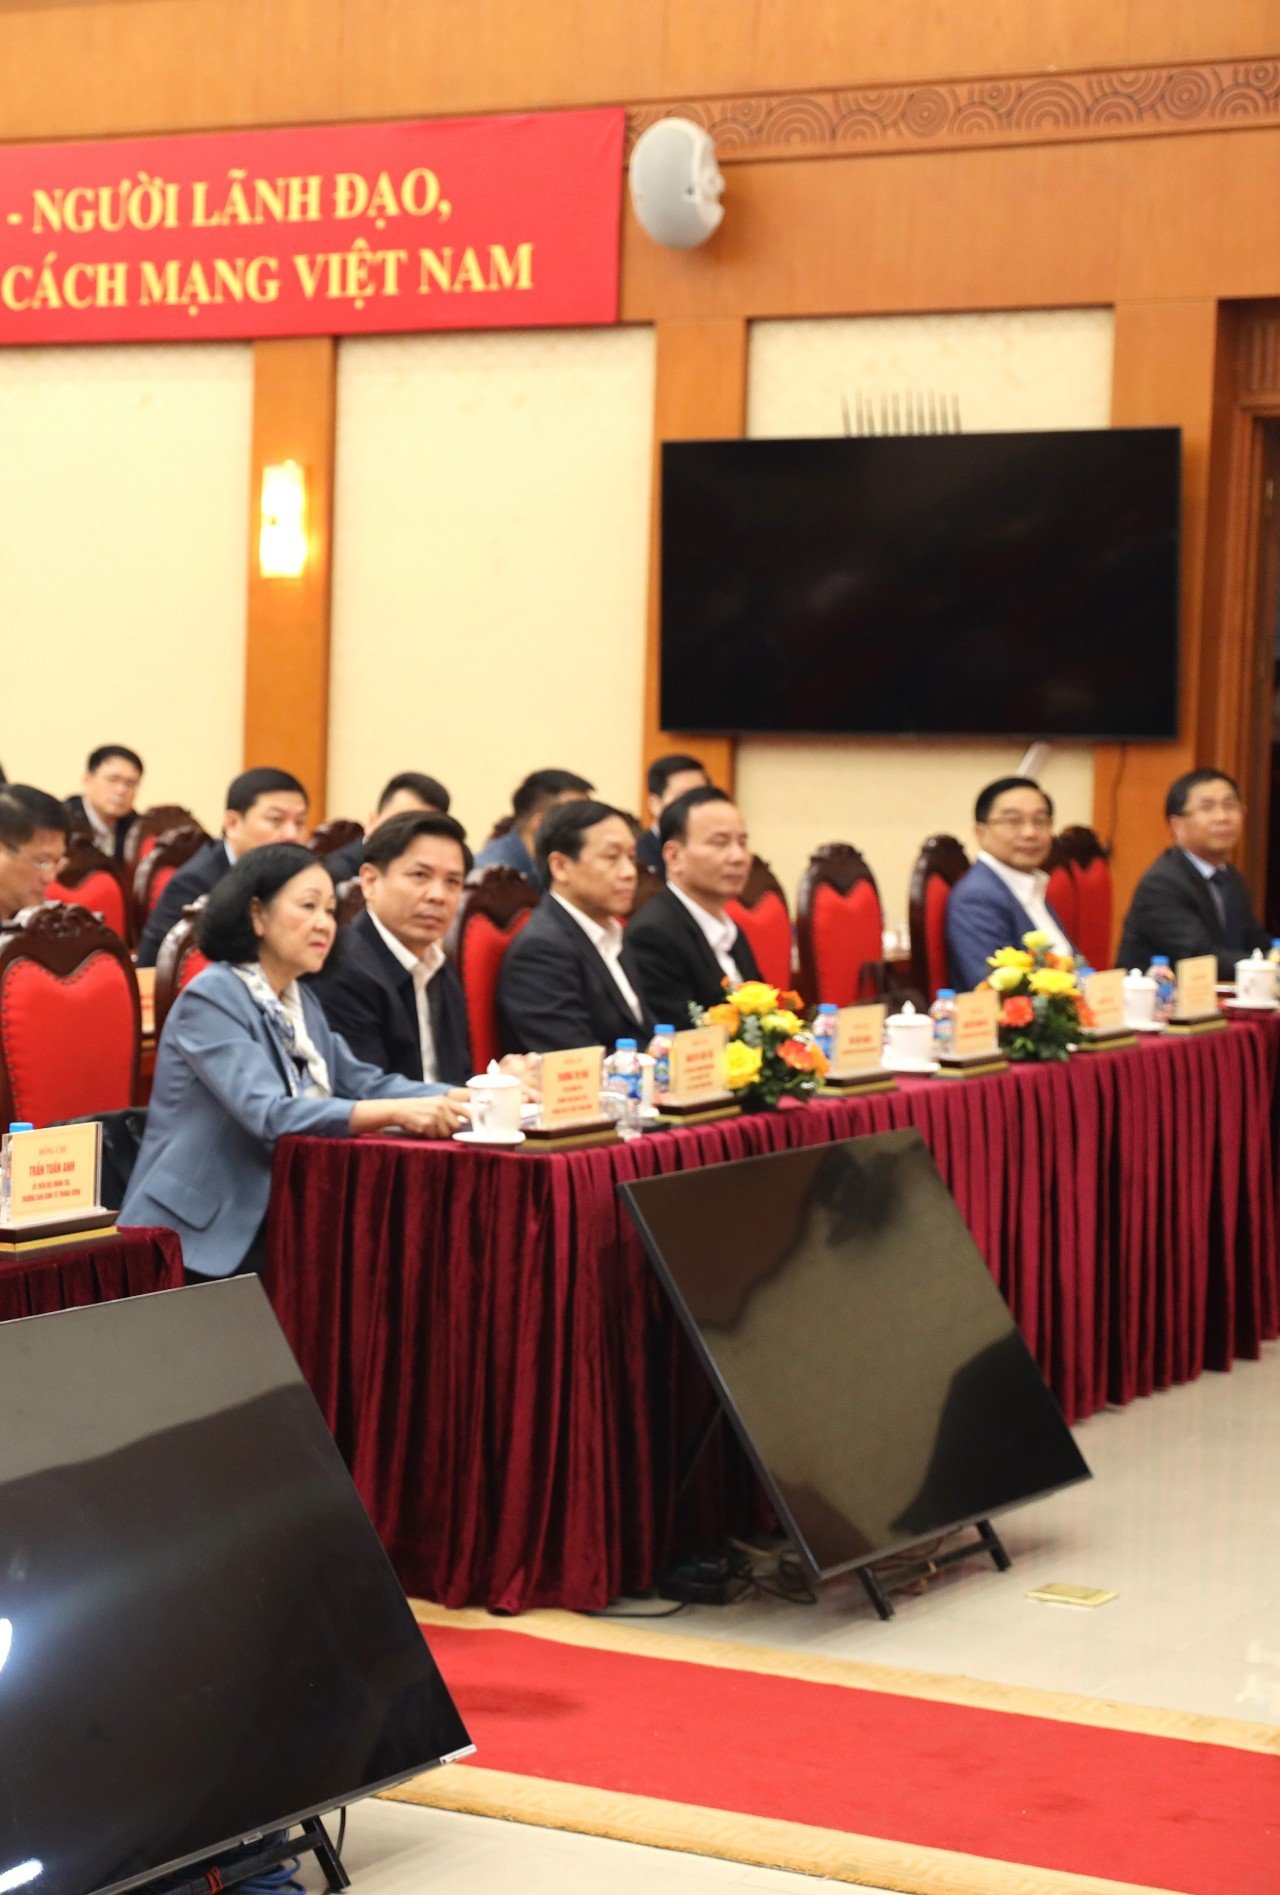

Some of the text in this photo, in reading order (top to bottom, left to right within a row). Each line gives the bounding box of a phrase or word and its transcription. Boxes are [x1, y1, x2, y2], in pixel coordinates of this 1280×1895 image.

[32, 170, 180, 234] NGƯỜI
[191, 168, 322, 227] LÃNH
[333, 167, 452, 229] ĐẠO,
[1, 251, 128, 311] CÁCH
[140, 256, 280, 316] MẠNG
[293, 237, 408, 309] VIỆT
[419, 242, 533, 294] NAM
